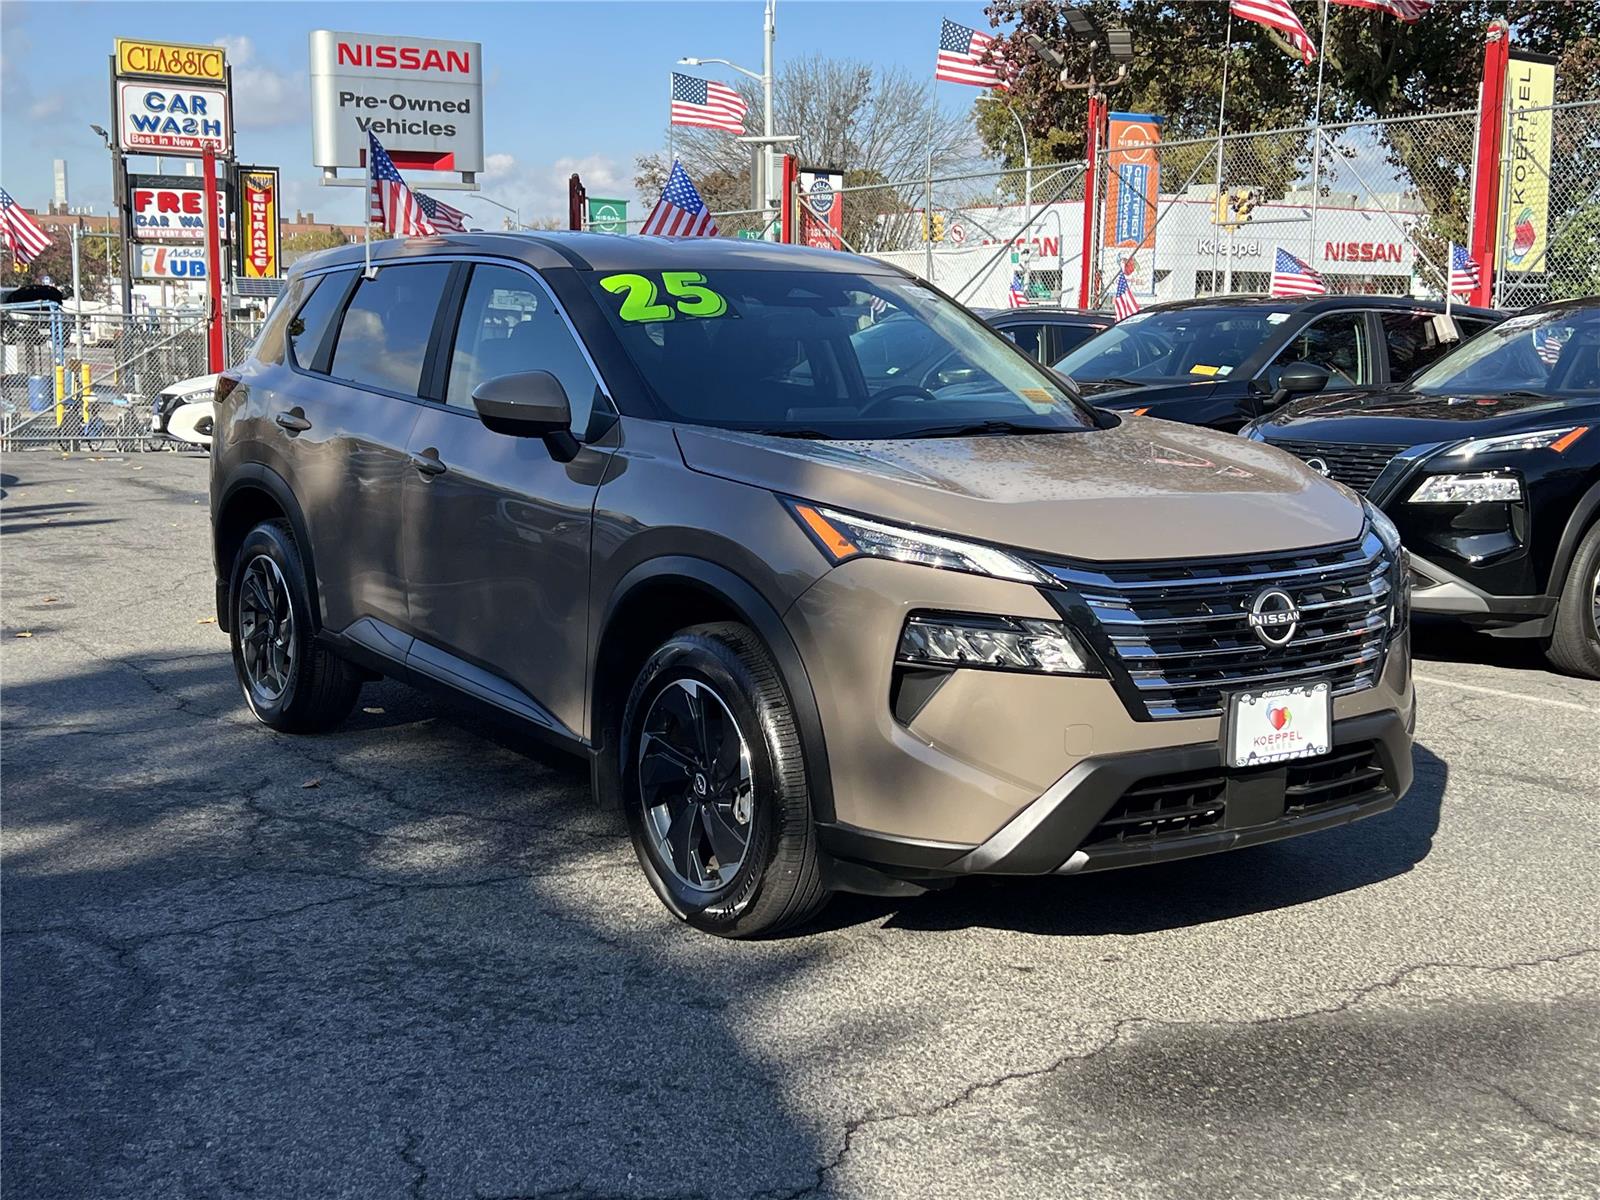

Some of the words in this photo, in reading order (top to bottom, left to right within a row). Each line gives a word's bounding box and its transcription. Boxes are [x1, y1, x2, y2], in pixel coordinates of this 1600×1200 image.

[127, 46, 219, 77] CLASSIC
[337, 43, 470, 73] NISSAN
[143, 91, 207, 115] CAR
[339, 91, 470, 114] Pre-Owned
[130, 114, 221, 136] WASH
[355, 117, 456, 137] Vehicles
[132, 133, 155, 144] Best
[172, 137, 194, 147] New
[198, 139, 220, 148] Yk
[1118, 137, 1153, 147] NISSAN
[1513, 68, 1532, 205] KOEPPEL
[135, 215, 169, 227] CAR
[179, 216, 225, 228] WA
[252, 193, 267, 266] ENTRANCE
[1325, 241, 1402, 263] NISSAN
[599, 271, 728, 324] 25
[1250, 610, 1300, 626] NISSAN
[1253, 731, 1303, 747] KOEPPEL
[1248, 749, 1317, 766] KOEPPEL
